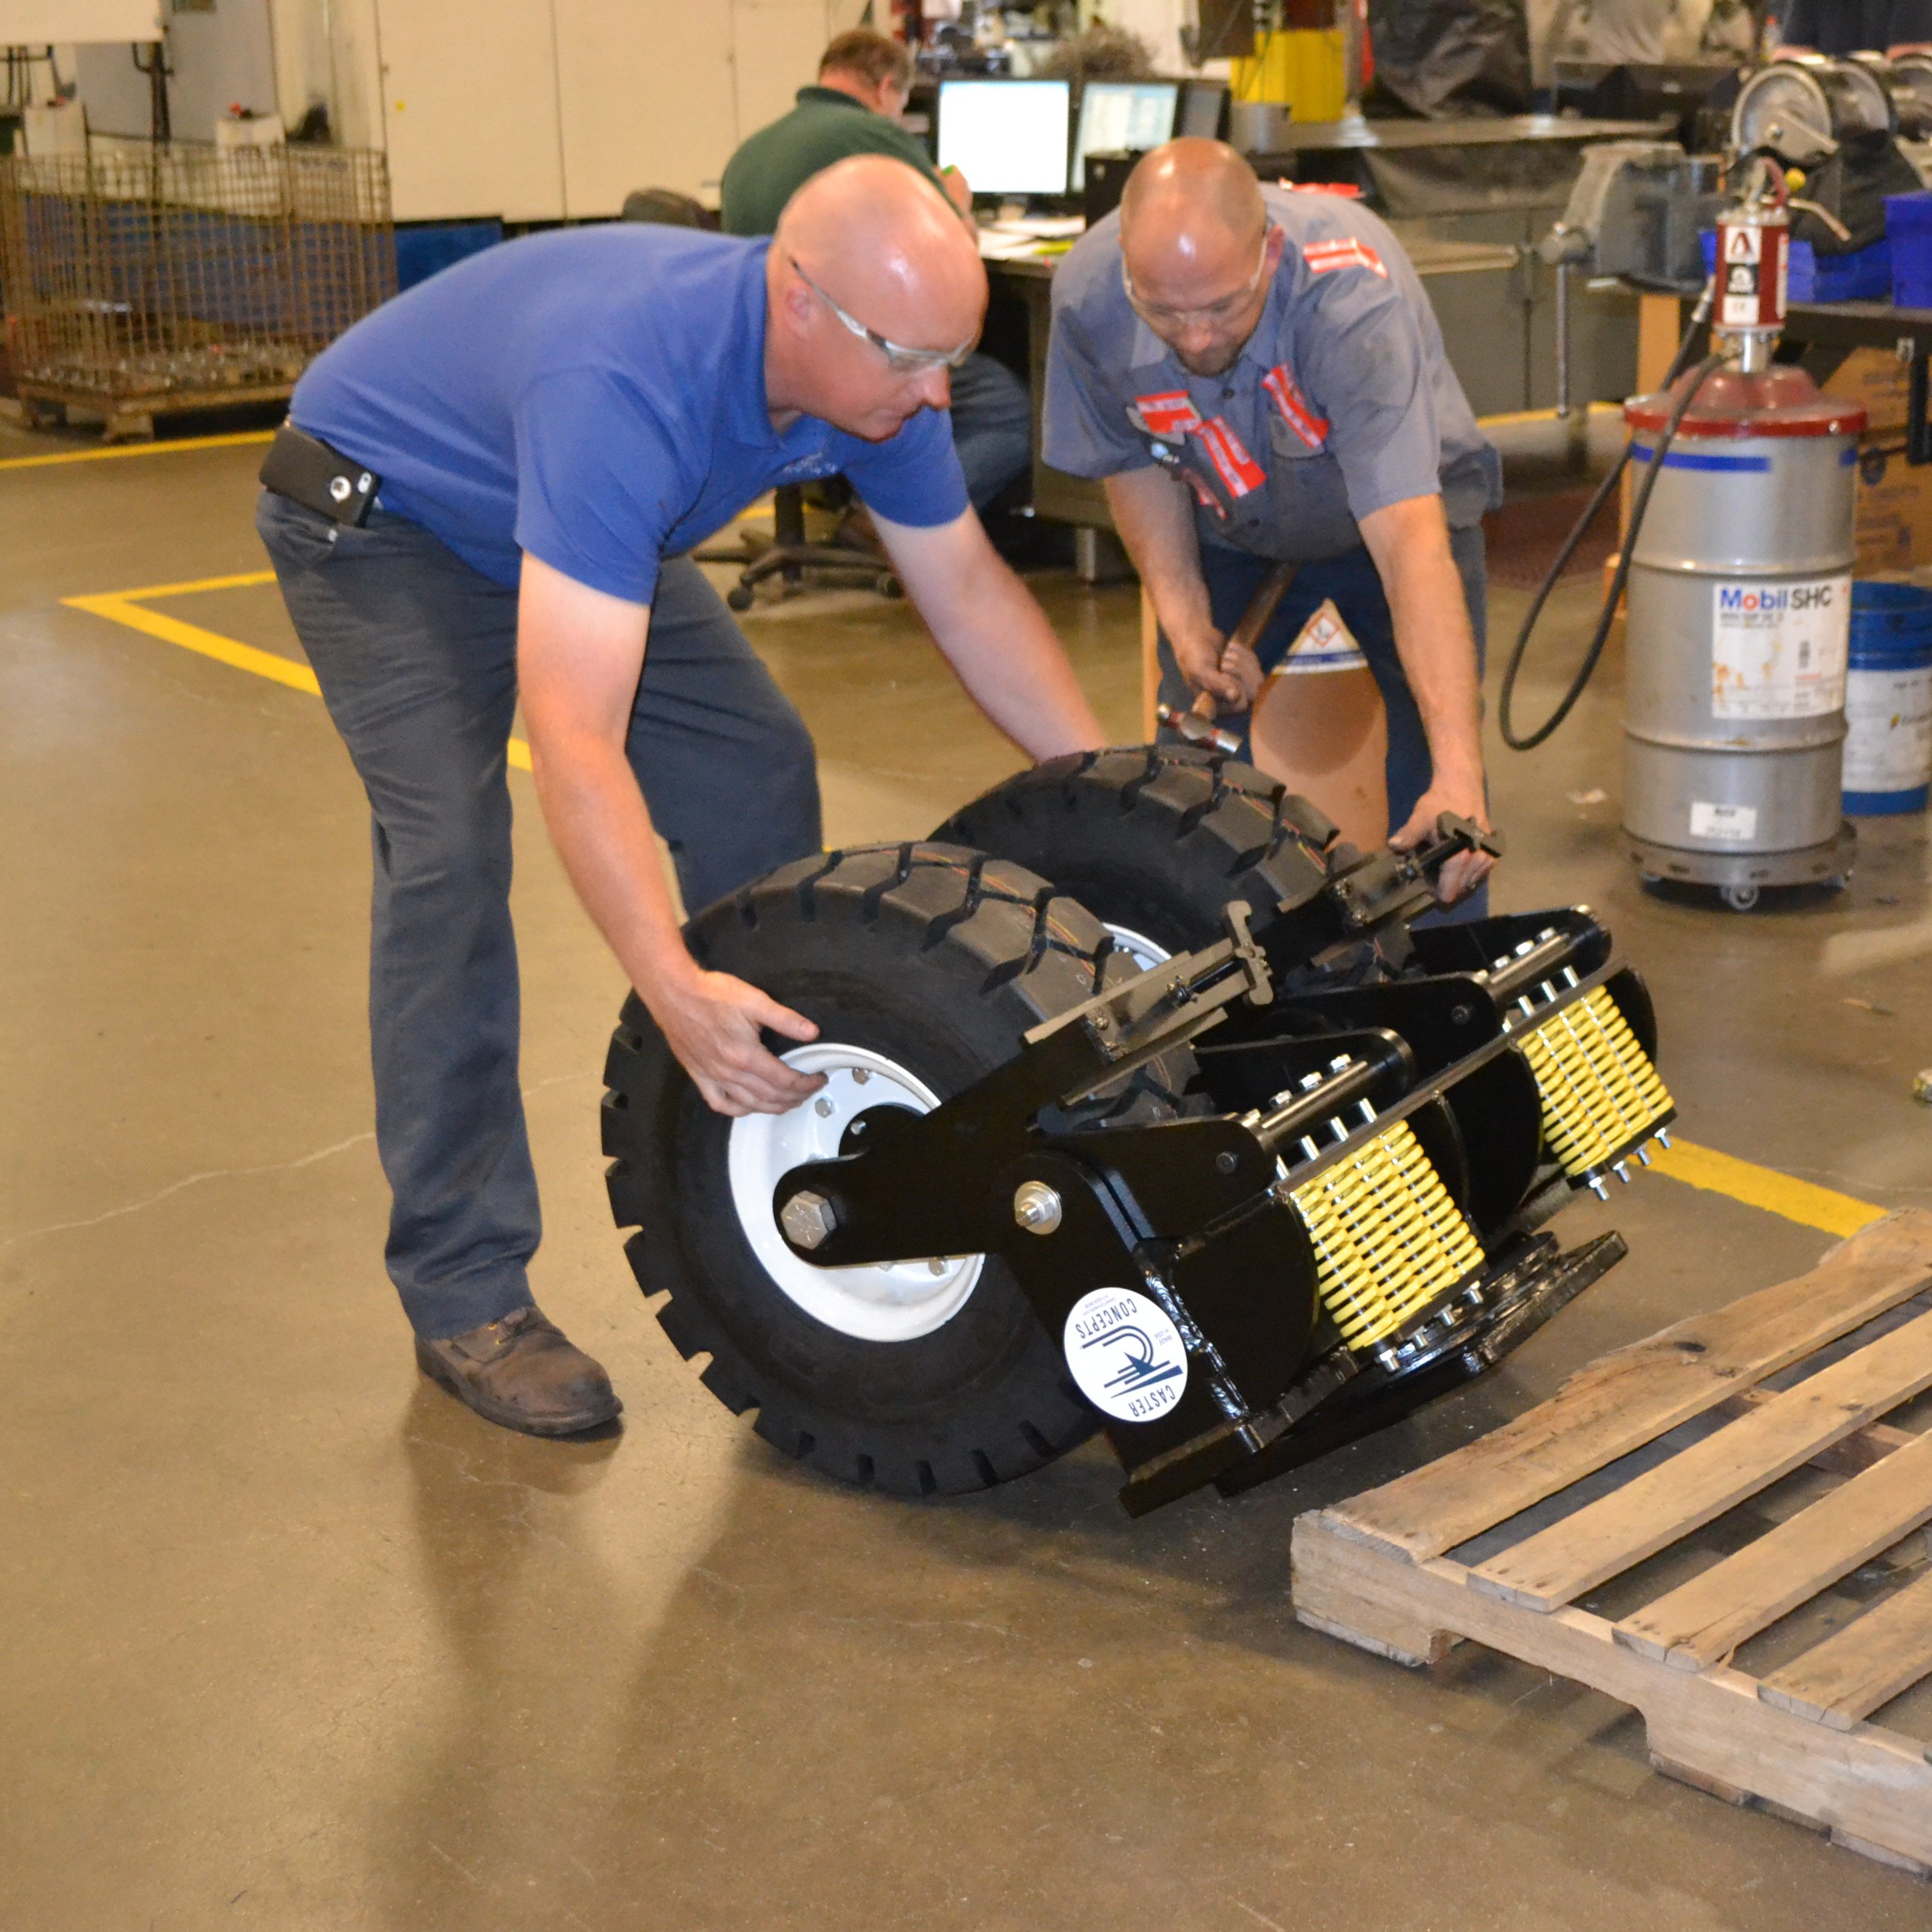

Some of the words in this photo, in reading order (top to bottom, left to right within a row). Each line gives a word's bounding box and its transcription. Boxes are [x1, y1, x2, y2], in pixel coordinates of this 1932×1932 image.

[1721, 589, 1788, 610] Mobil
[1791, 586, 1832, 610] SHC
[1075, 1298, 1138, 1339] CONCEPTS
[1128, 1385, 1175, 1417] CASTER
